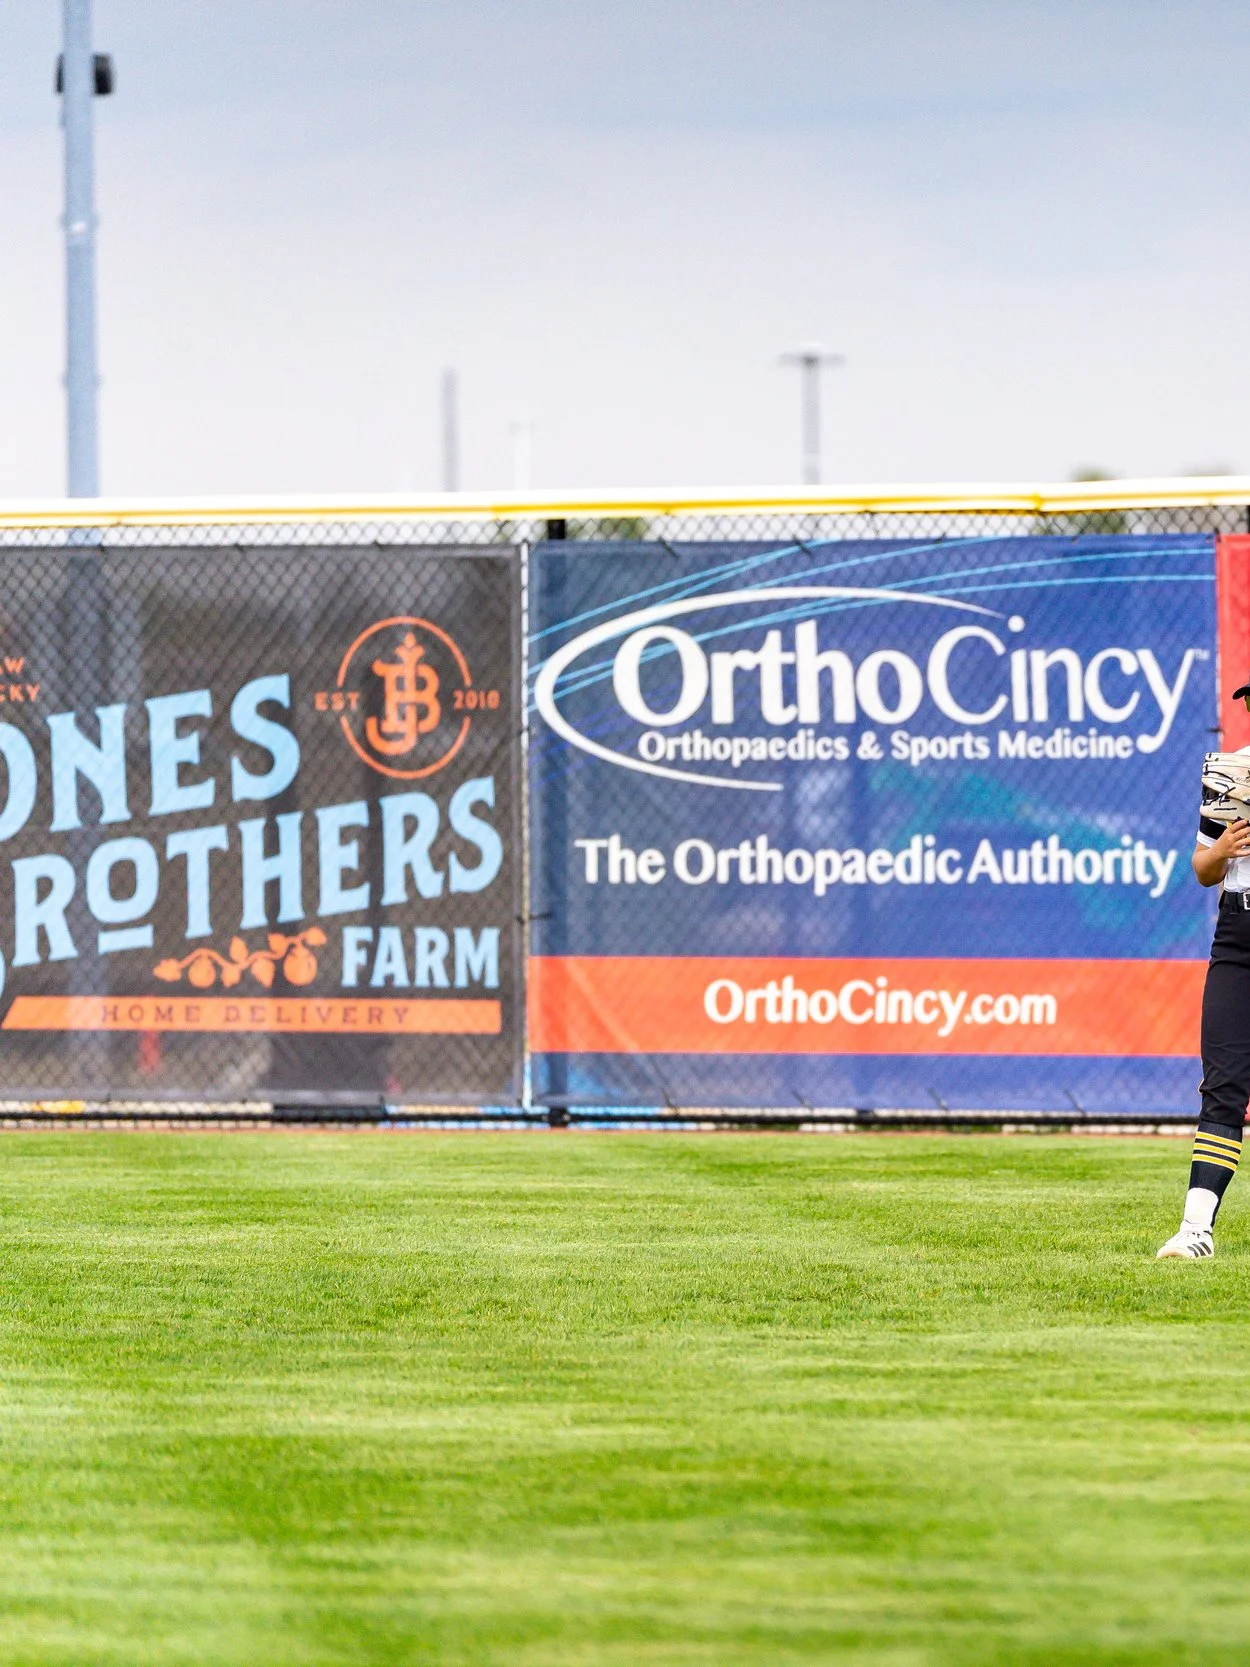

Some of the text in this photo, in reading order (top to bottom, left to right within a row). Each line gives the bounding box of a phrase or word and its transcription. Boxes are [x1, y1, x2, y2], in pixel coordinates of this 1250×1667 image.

[0, 656, 25, 674] W
[612, 618, 1195, 754] OrthoCincy
[315, 691, 360, 712] EST
[453, 689, 501, 710] 2010
[638, 728, 1134, 766] Orthopaedics & Sports Medicine
[0, 776, 502, 990] ROTHERS
[575, 834, 1176, 898] The Orthopaedic Authority
[341, 926, 500, 988] FARM
[102, 1004, 411, 1026] HOME DELIVERY
[704, 976, 1057, 1037] OrthoCincy.com
